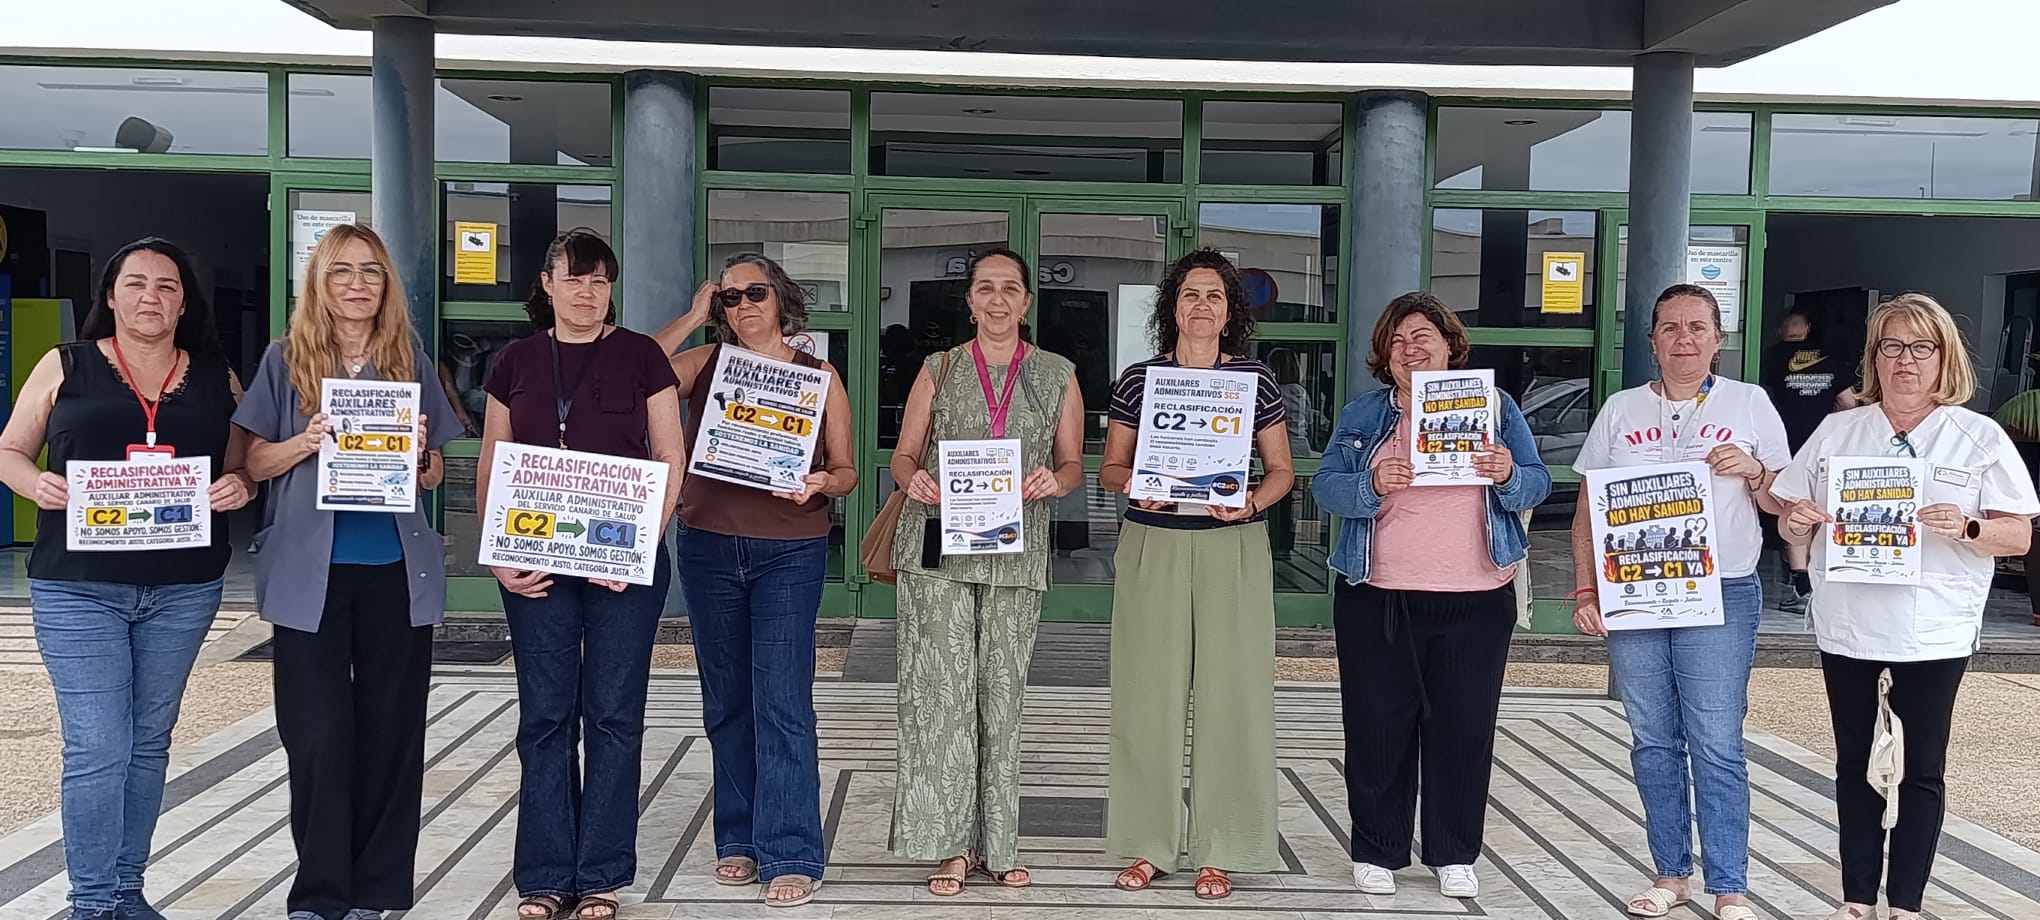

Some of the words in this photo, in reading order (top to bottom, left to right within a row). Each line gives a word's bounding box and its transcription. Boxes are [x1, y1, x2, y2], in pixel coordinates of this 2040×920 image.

[723, 364, 802, 391] AUXILIARES
[728, 356, 821, 384] RECLASIFICACIÓN
[722, 376, 800, 398] ADMINISTRATIVOS
[1155, 378, 1200, 388] AUXILIARES
[1427, 382, 1440, 392] SIN
[1441, 379, 1482, 390] AUXILIARES
[332, 388, 412, 398] RECLASIFICACIÓN
[799, 390, 818, 406] YA
[1154, 388, 1222, 398] ADMINISTRATIVOS
[1224, 392, 1240, 400] SCS
[1426, 388, 1484, 400] ADMINISTRATIVOS
[330, 398, 397, 408] AUXILIARES
[1154, 402, 1242, 414] RECLASIFICACIÓN
[1425, 402, 1436, 412] NO
[1440, 400, 1453, 410] HAY
[1455, 398, 1486, 409] SANIDAD
[330, 408, 396, 417] ADMINISTRATIVOS
[396, 408, 412, 423] YA
[733, 406, 756, 423] C2
[782, 416, 804, 434] C1
[1153, 412, 1186, 430] C2
[1211, 415, 1241, 435] C1
[344, 435, 364, 450] C2
[386, 436, 404, 451] C1
[1427, 441, 1442, 452] C2
[1456, 440, 1470, 452] C1
[90, 464, 190, 478] RECLASIFICACIÓN
[520, 452, 642, 482] RECLASIFICACIÓN
[948, 469, 1012, 477] RECLASIFICACIÓN
[1846, 470, 1860, 480] SIN
[1862, 468, 1908, 479] AUXILIARES
[86, 478, 182, 490] ADMINISTRATIVA
[184, 476, 198, 486] YA
[512, 470, 628, 496] ADMINISTRATIVA
[632, 484, 648, 500] YA
[950, 478, 974, 494] C2
[992, 478, 1012, 492] C1
[1610, 482, 1629, 496] SIN
[1631, 474, 1692, 493] AUXILIARES
[1844, 478, 1910, 490] ADMINISTRATIVOS
[88, 493, 130, 501] AUXILIAR
[134, 490, 196, 499] ADMINISTRATIVO
[512, 489, 562, 504] AUXILIAR
[566, 494, 644, 514] ADMINISTRATIVO
[1611, 487, 1696, 509] ADMINISTRATIVOS
[1842, 490, 1856, 500] NO
[1858, 489, 1874, 500] HAY
[1876, 488, 1912, 499] SANIDAD
[92, 508, 122, 524] C2
[160, 508, 188, 522] C1
[518, 500, 531, 508] DEL
[534, 502, 566, 512] SERVICIO
[568, 506, 600, 516] CANARIO
[614, 511, 636, 521] SALUD
[1610, 510, 1627, 525] NO
[1630, 506, 1651, 522] HAY
[1653, 501, 1701, 518] SANIDAD
[80, 527, 92, 536] NO
[95, 527, 120, 536] SOMOS
[149, 526, 172, 534] SOMOS
[514, 512, 549, 536] C2
[595, 522, 628, 546] C1
[1845, 524, 1907, 534] RECLASIFICACIÓN
[1844, 533, 1862, 544] C2
[1878, 534, 1893, 546] C1
[1896, 535, 1908, 546] YA
[496, 536, 510, 548] NO
[514, 538, 544, 552] SOMOS
[579, 545, 608, 560] SOMOS
[610, 550, 642, 564] GESTIÓN
[1618, 550, 1700, 565] RECLASIFICACIÓN
[492, 552, 550, 567] RECONOCIMIENTO
[574, 561, 608, 574] CATEGORÍA
[610, 566, 630, 576] JUSTA
[1620, 565, 1642, 582] C2
[1664, 562, 1682, 578] C1
[1686, 562, 1704, 575] YA
